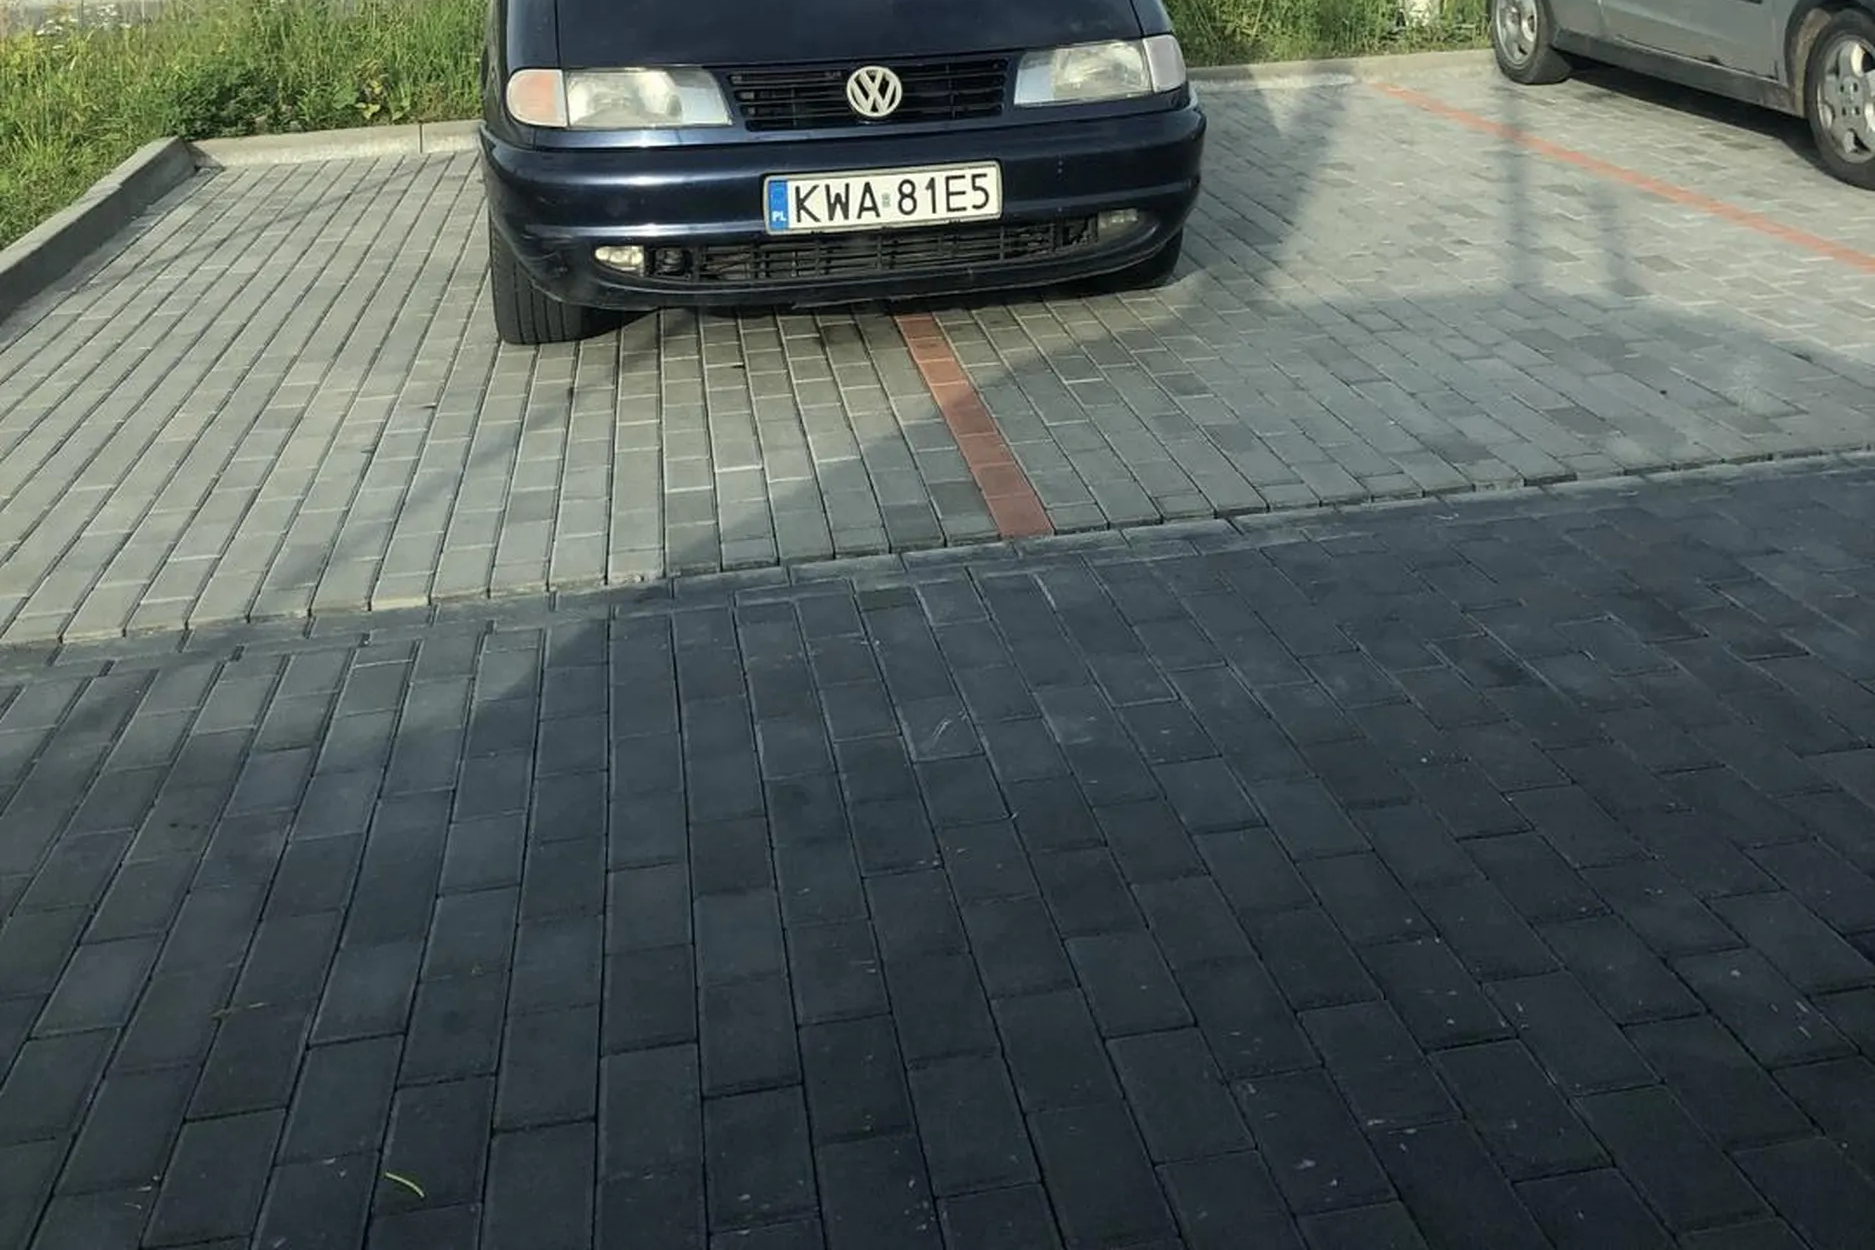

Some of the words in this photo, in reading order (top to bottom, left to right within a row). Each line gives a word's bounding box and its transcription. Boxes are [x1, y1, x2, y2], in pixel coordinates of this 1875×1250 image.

[848, 66, 902, 117] VW
[772, 211, 787, 222] PL
[794, 181, 881, 223] KWA
[898, 173, 990, 216] 81E5
